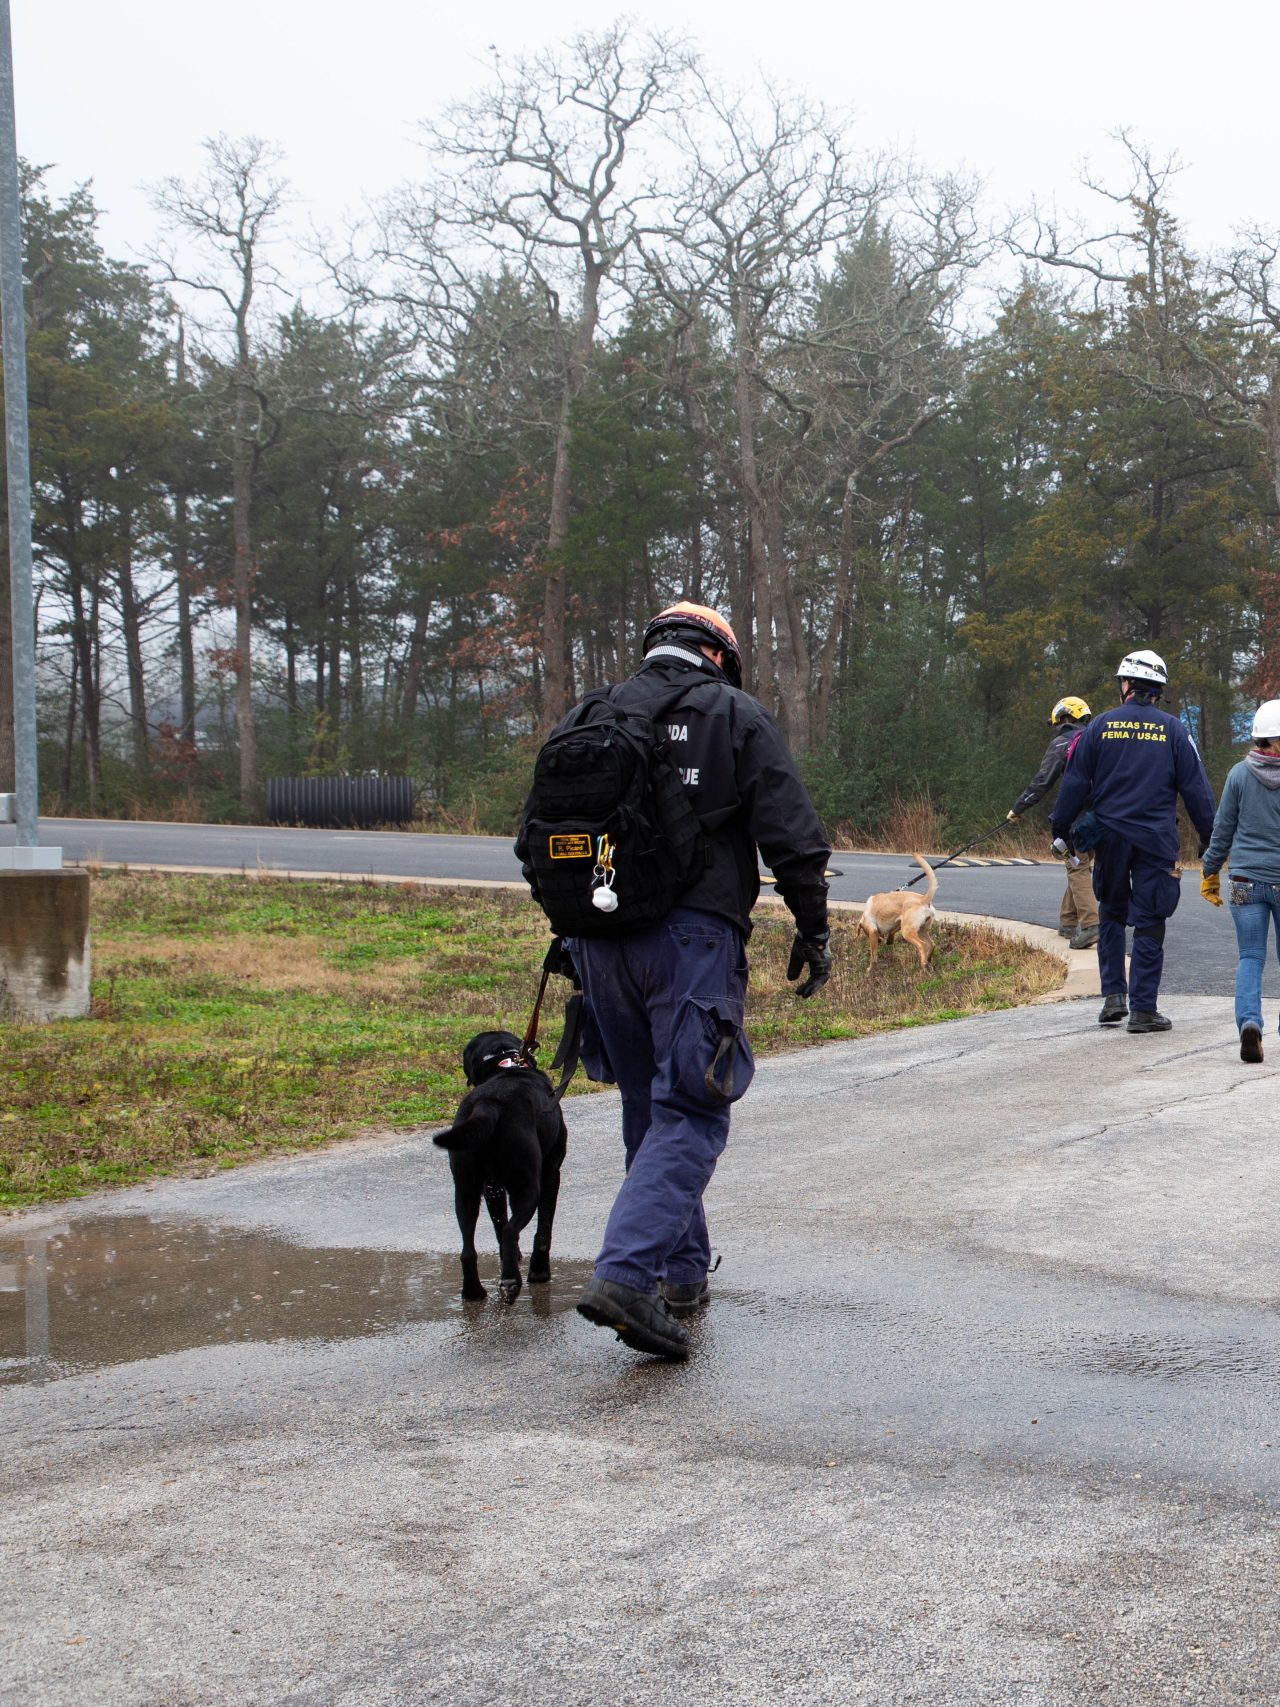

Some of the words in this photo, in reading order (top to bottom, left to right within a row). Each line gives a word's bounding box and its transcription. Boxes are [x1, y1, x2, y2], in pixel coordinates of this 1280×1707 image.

[1107, 721, 1140, 729] TEXAS
[1143, 722, 1164, 731] TF-1
[1102, 731, 1129, 739] FEMA
[1137, 732, 1167, 742] US&R
